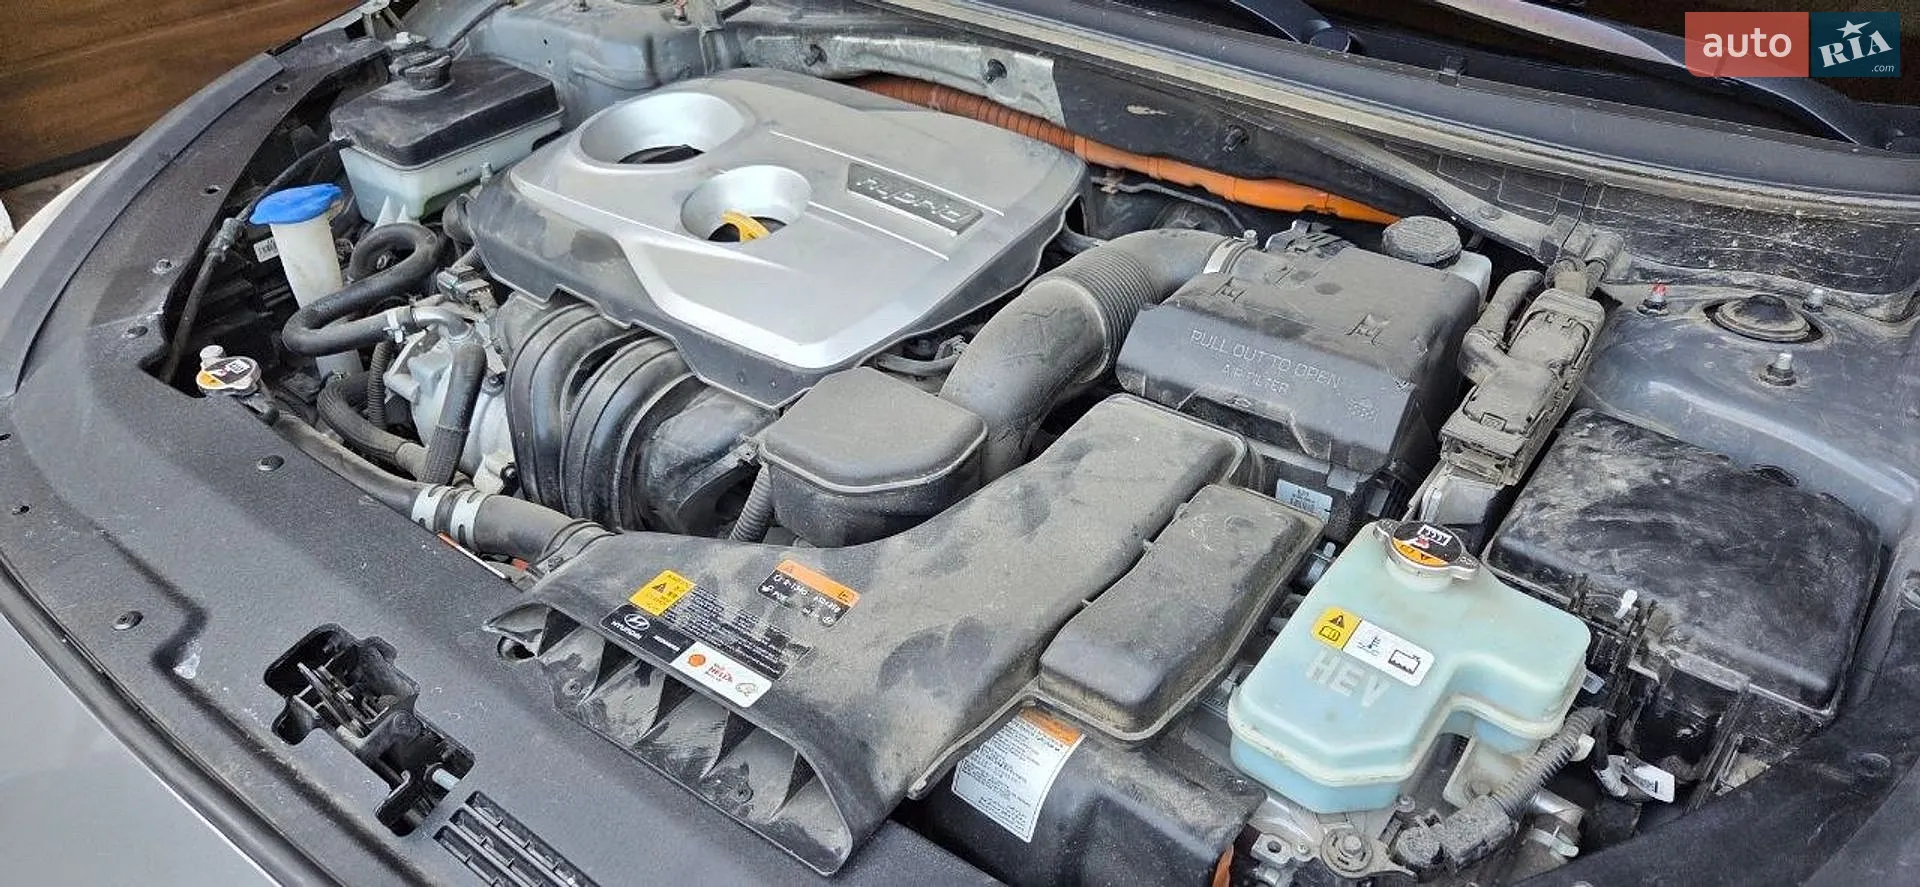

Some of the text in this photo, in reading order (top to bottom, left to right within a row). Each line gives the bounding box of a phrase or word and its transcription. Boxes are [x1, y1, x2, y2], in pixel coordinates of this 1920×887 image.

[1190, 328, 1343, 388] PULL OUT TO OPEN
[1222, 364, 1291, 394] AIR FILTER
[1306, 648, 1392, 708] HEV
